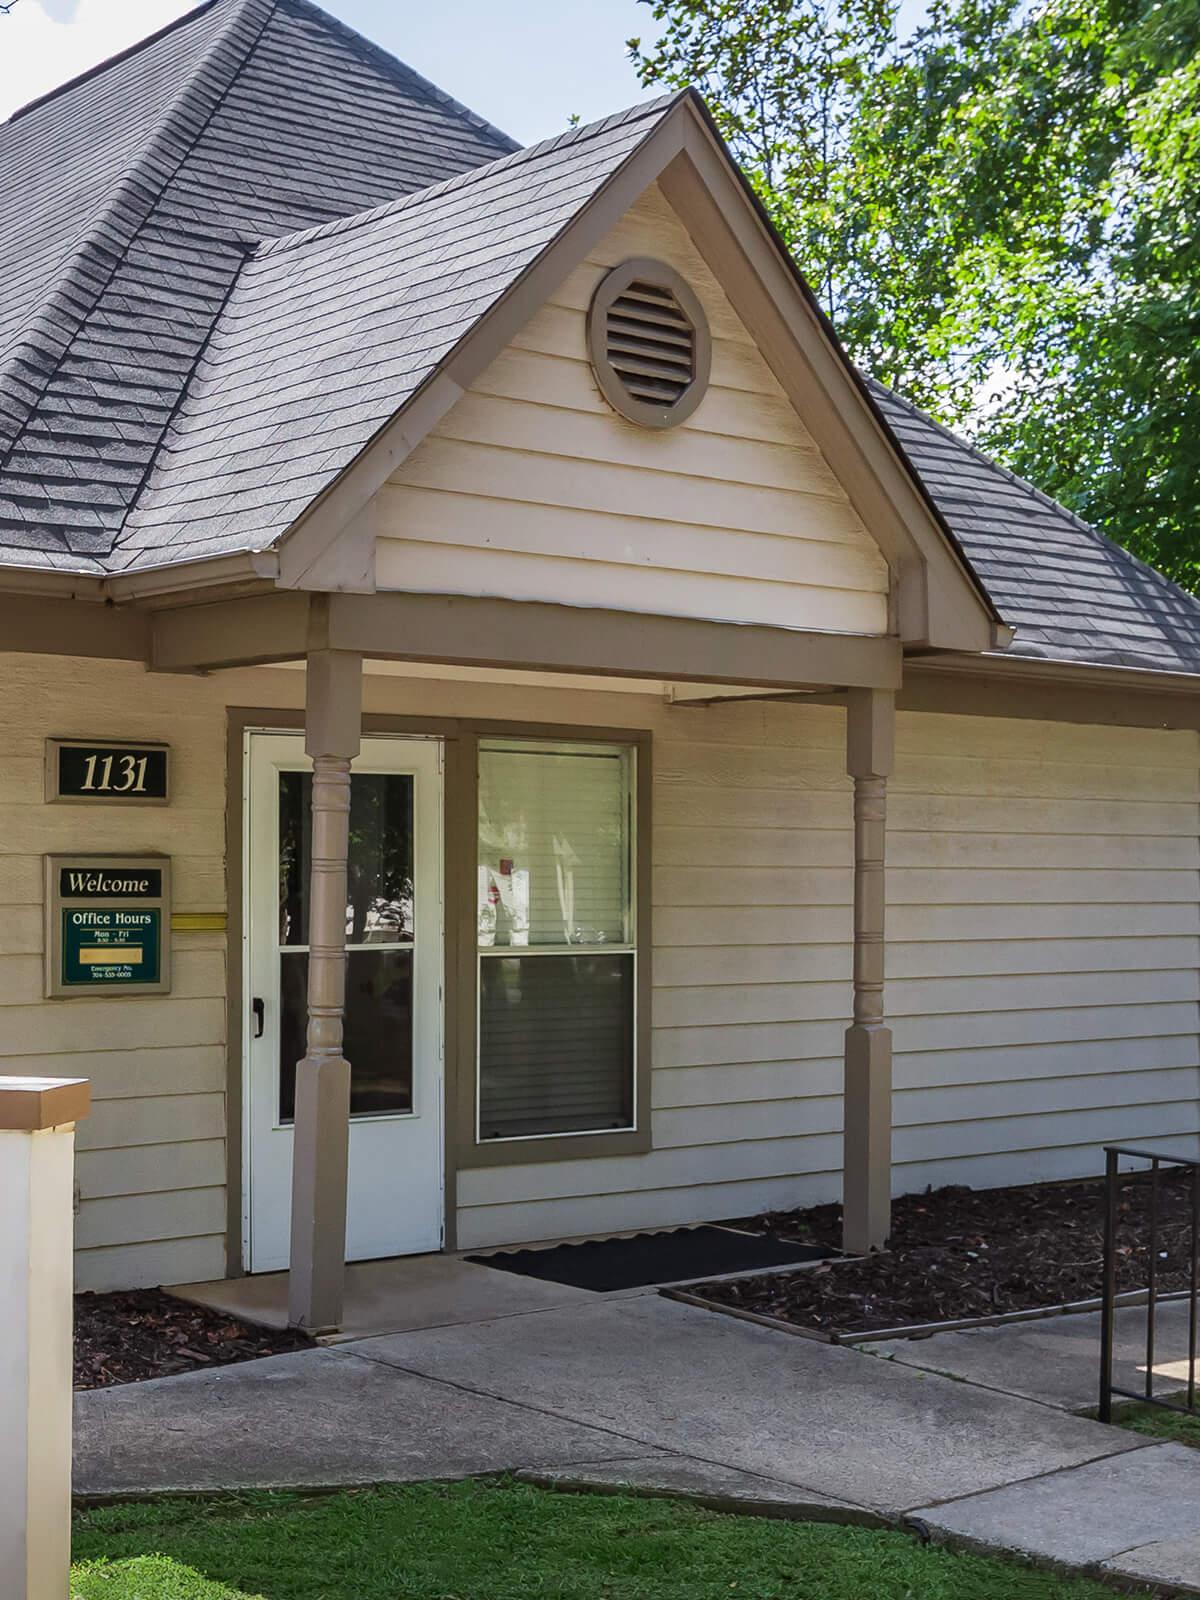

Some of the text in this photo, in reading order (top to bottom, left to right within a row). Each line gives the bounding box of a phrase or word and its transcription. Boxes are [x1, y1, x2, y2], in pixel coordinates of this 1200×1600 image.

[80, 754, 148, 792] 1131
[68, 872, 149, 893] Welcome
[72, 912, 152, 925] Office Hours
[94, 930, 110, 938] Mon
[118, 930, 129, 938] Fri
